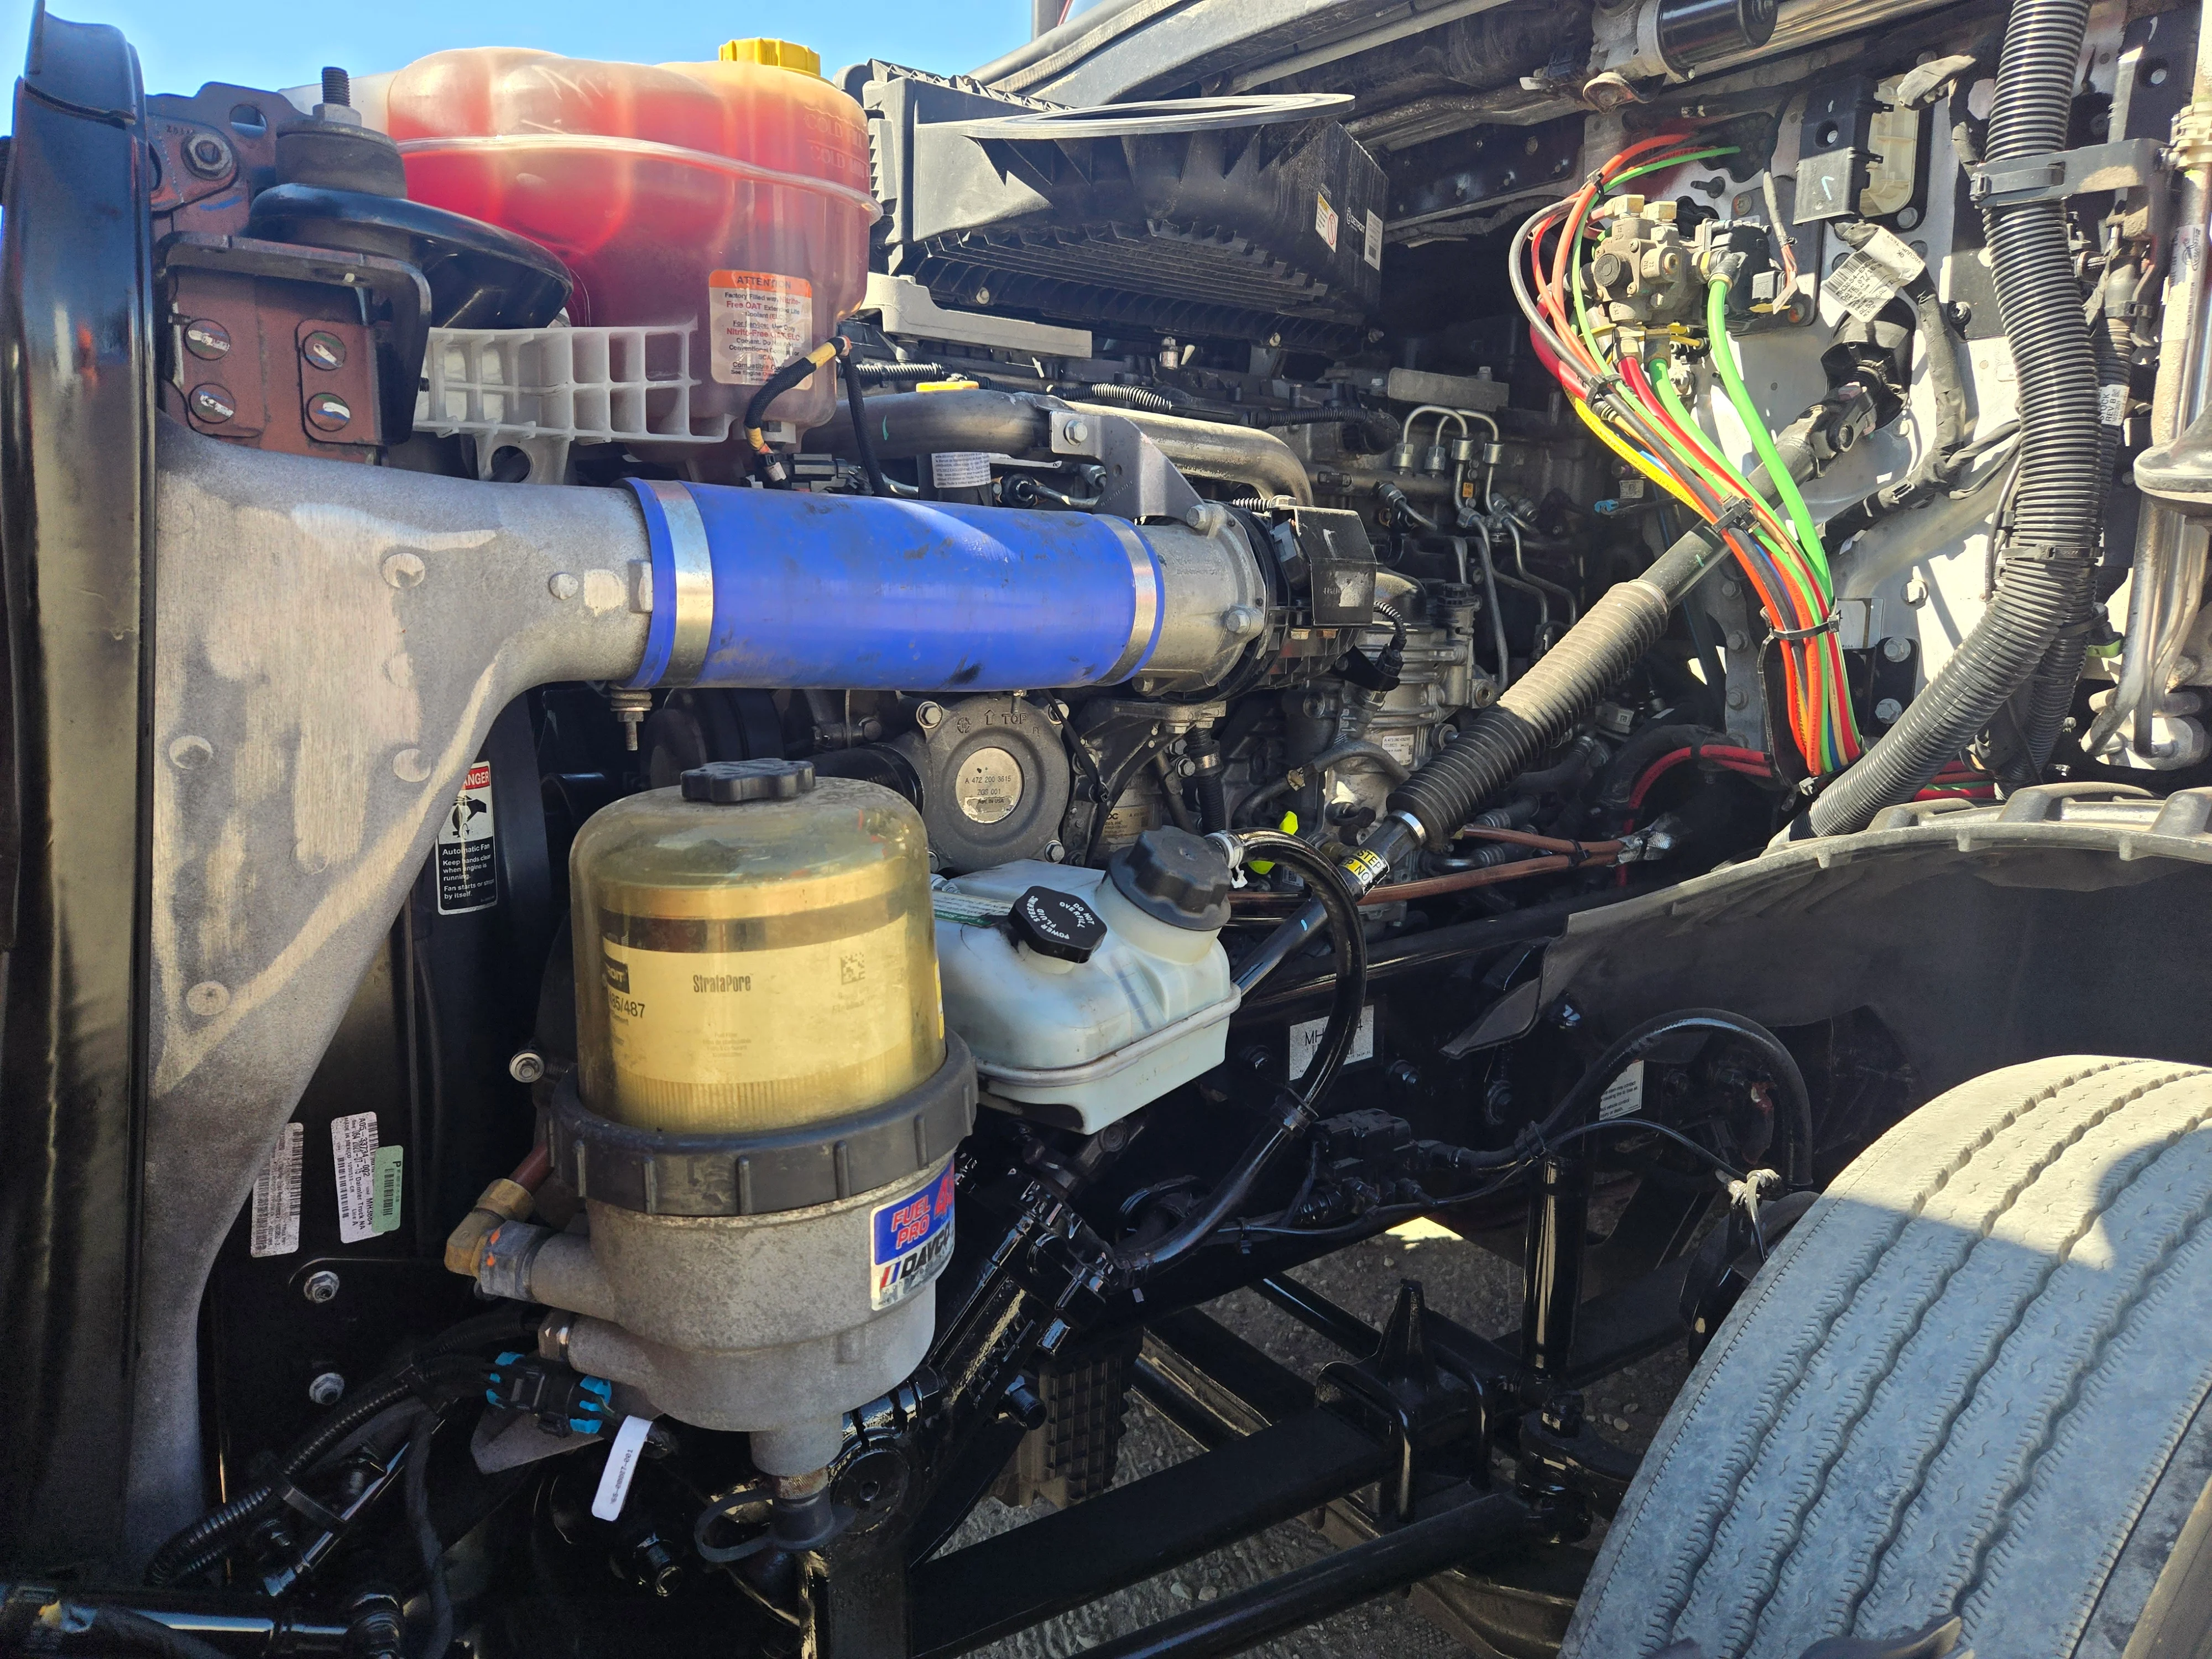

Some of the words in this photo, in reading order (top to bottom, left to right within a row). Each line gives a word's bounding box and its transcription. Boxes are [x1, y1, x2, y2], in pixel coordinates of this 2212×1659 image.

[1351, 215, 1365, 234] DETROIT
[1896, 249, 1905, 258] OK
[737, 275, 791, 289] ATTENTION
[725, 292, 747, 301] Factory
[2105, 406, 2115, 422] REV
[1002, 713, 1028, 725] TOP
[442, 845, 480, 855] Automatic
[1357, 848, 1381, 869] STEP
[1354, 865, 1370, 881] NO
[454, 890, 472, 899] itself.
[1026, 895, 1040, 923] STEERING
[1036, 908, 1057, 929] FLUID
[1059, 901, 1086, 928] OVERFILL
[1072, 902, 1084, 911] DO
[1083, 912, 1095, 925] NOT
[1041, 923, 1070, 940] POWER
[692, 974, 751, 993] StrataPore
[358, 1118, 371, 1177] A05-33734-002
[354, 1176, 363, 1200] Daimler
[891, 1194, 931, 1232] FUEL
[358, 1220, 365, 1229] NA
[895, 1214, 930, 1250] PRO
[899, 1220, 951, 1280] DAVCO
